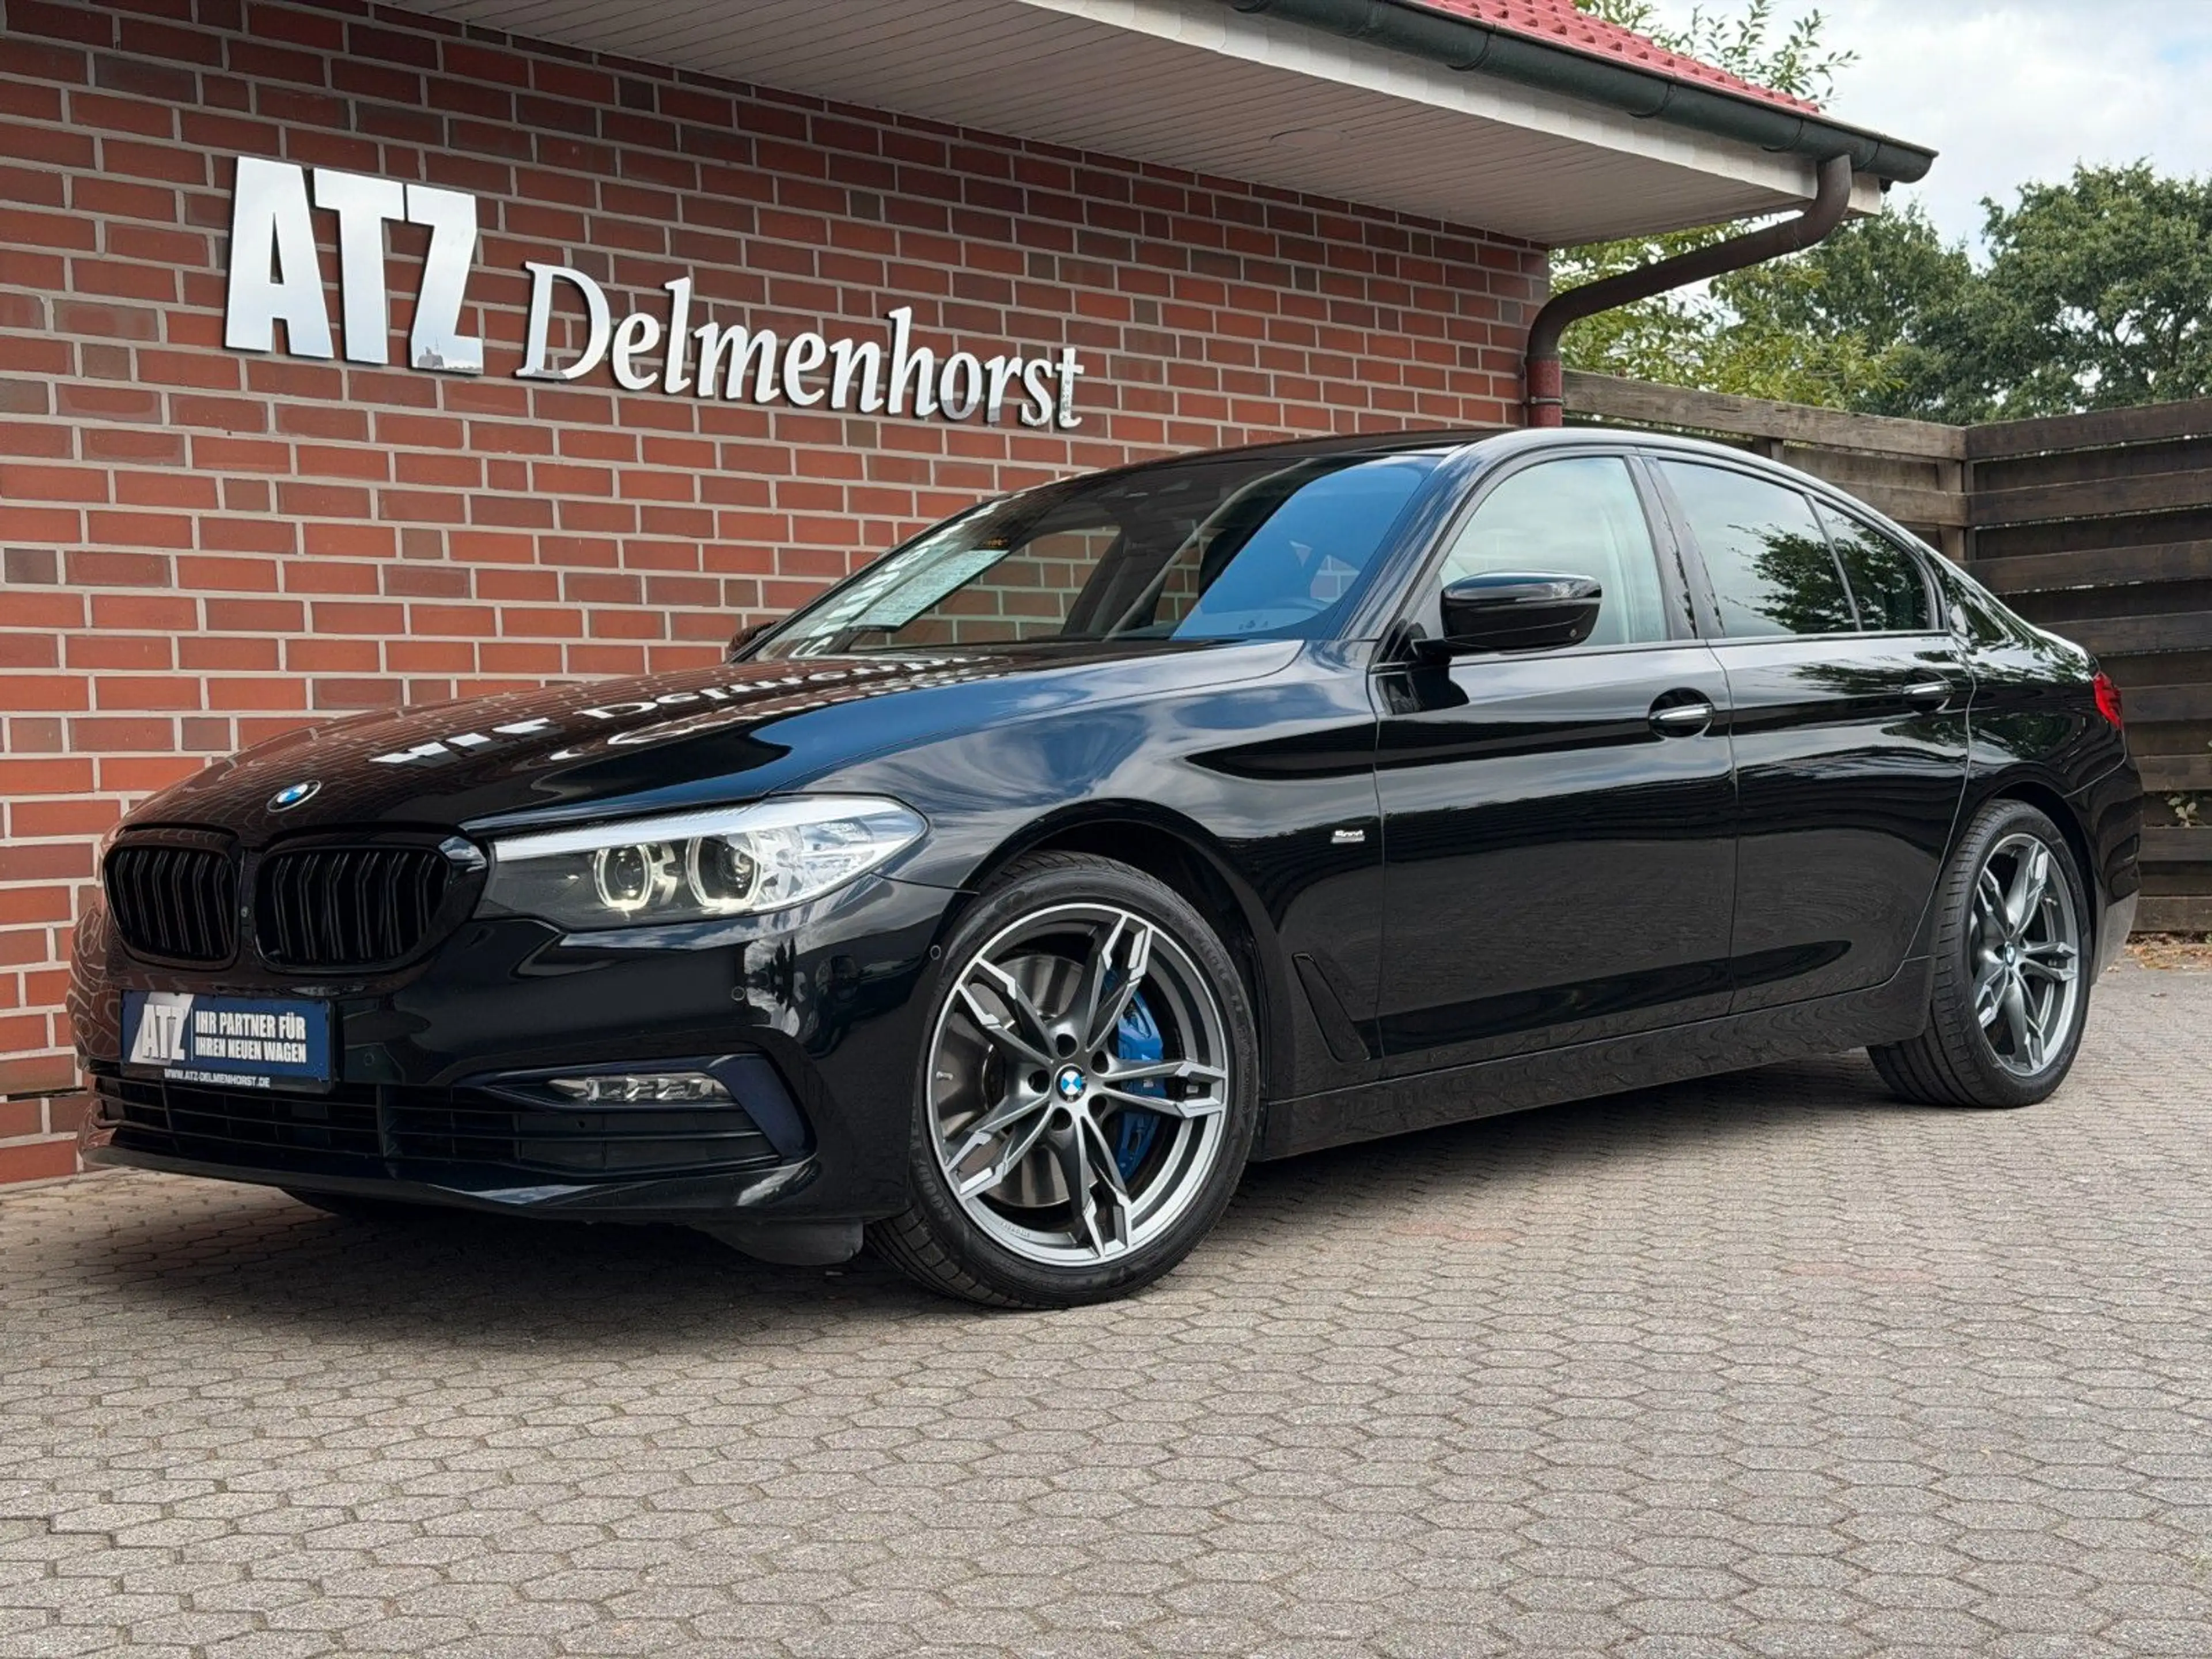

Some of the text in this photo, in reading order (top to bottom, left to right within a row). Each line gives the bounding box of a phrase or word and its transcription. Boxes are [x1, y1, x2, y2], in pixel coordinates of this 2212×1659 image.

[225, 156, 1084, 429] ATZ Delmenhorst
[142, 1003, 185, 1060] ATZ
[195, 1011, 306, 1040] IHR PARTNER FÜR
[195, 1036, 307, 1063] IHREN NEUEN WAGEN
